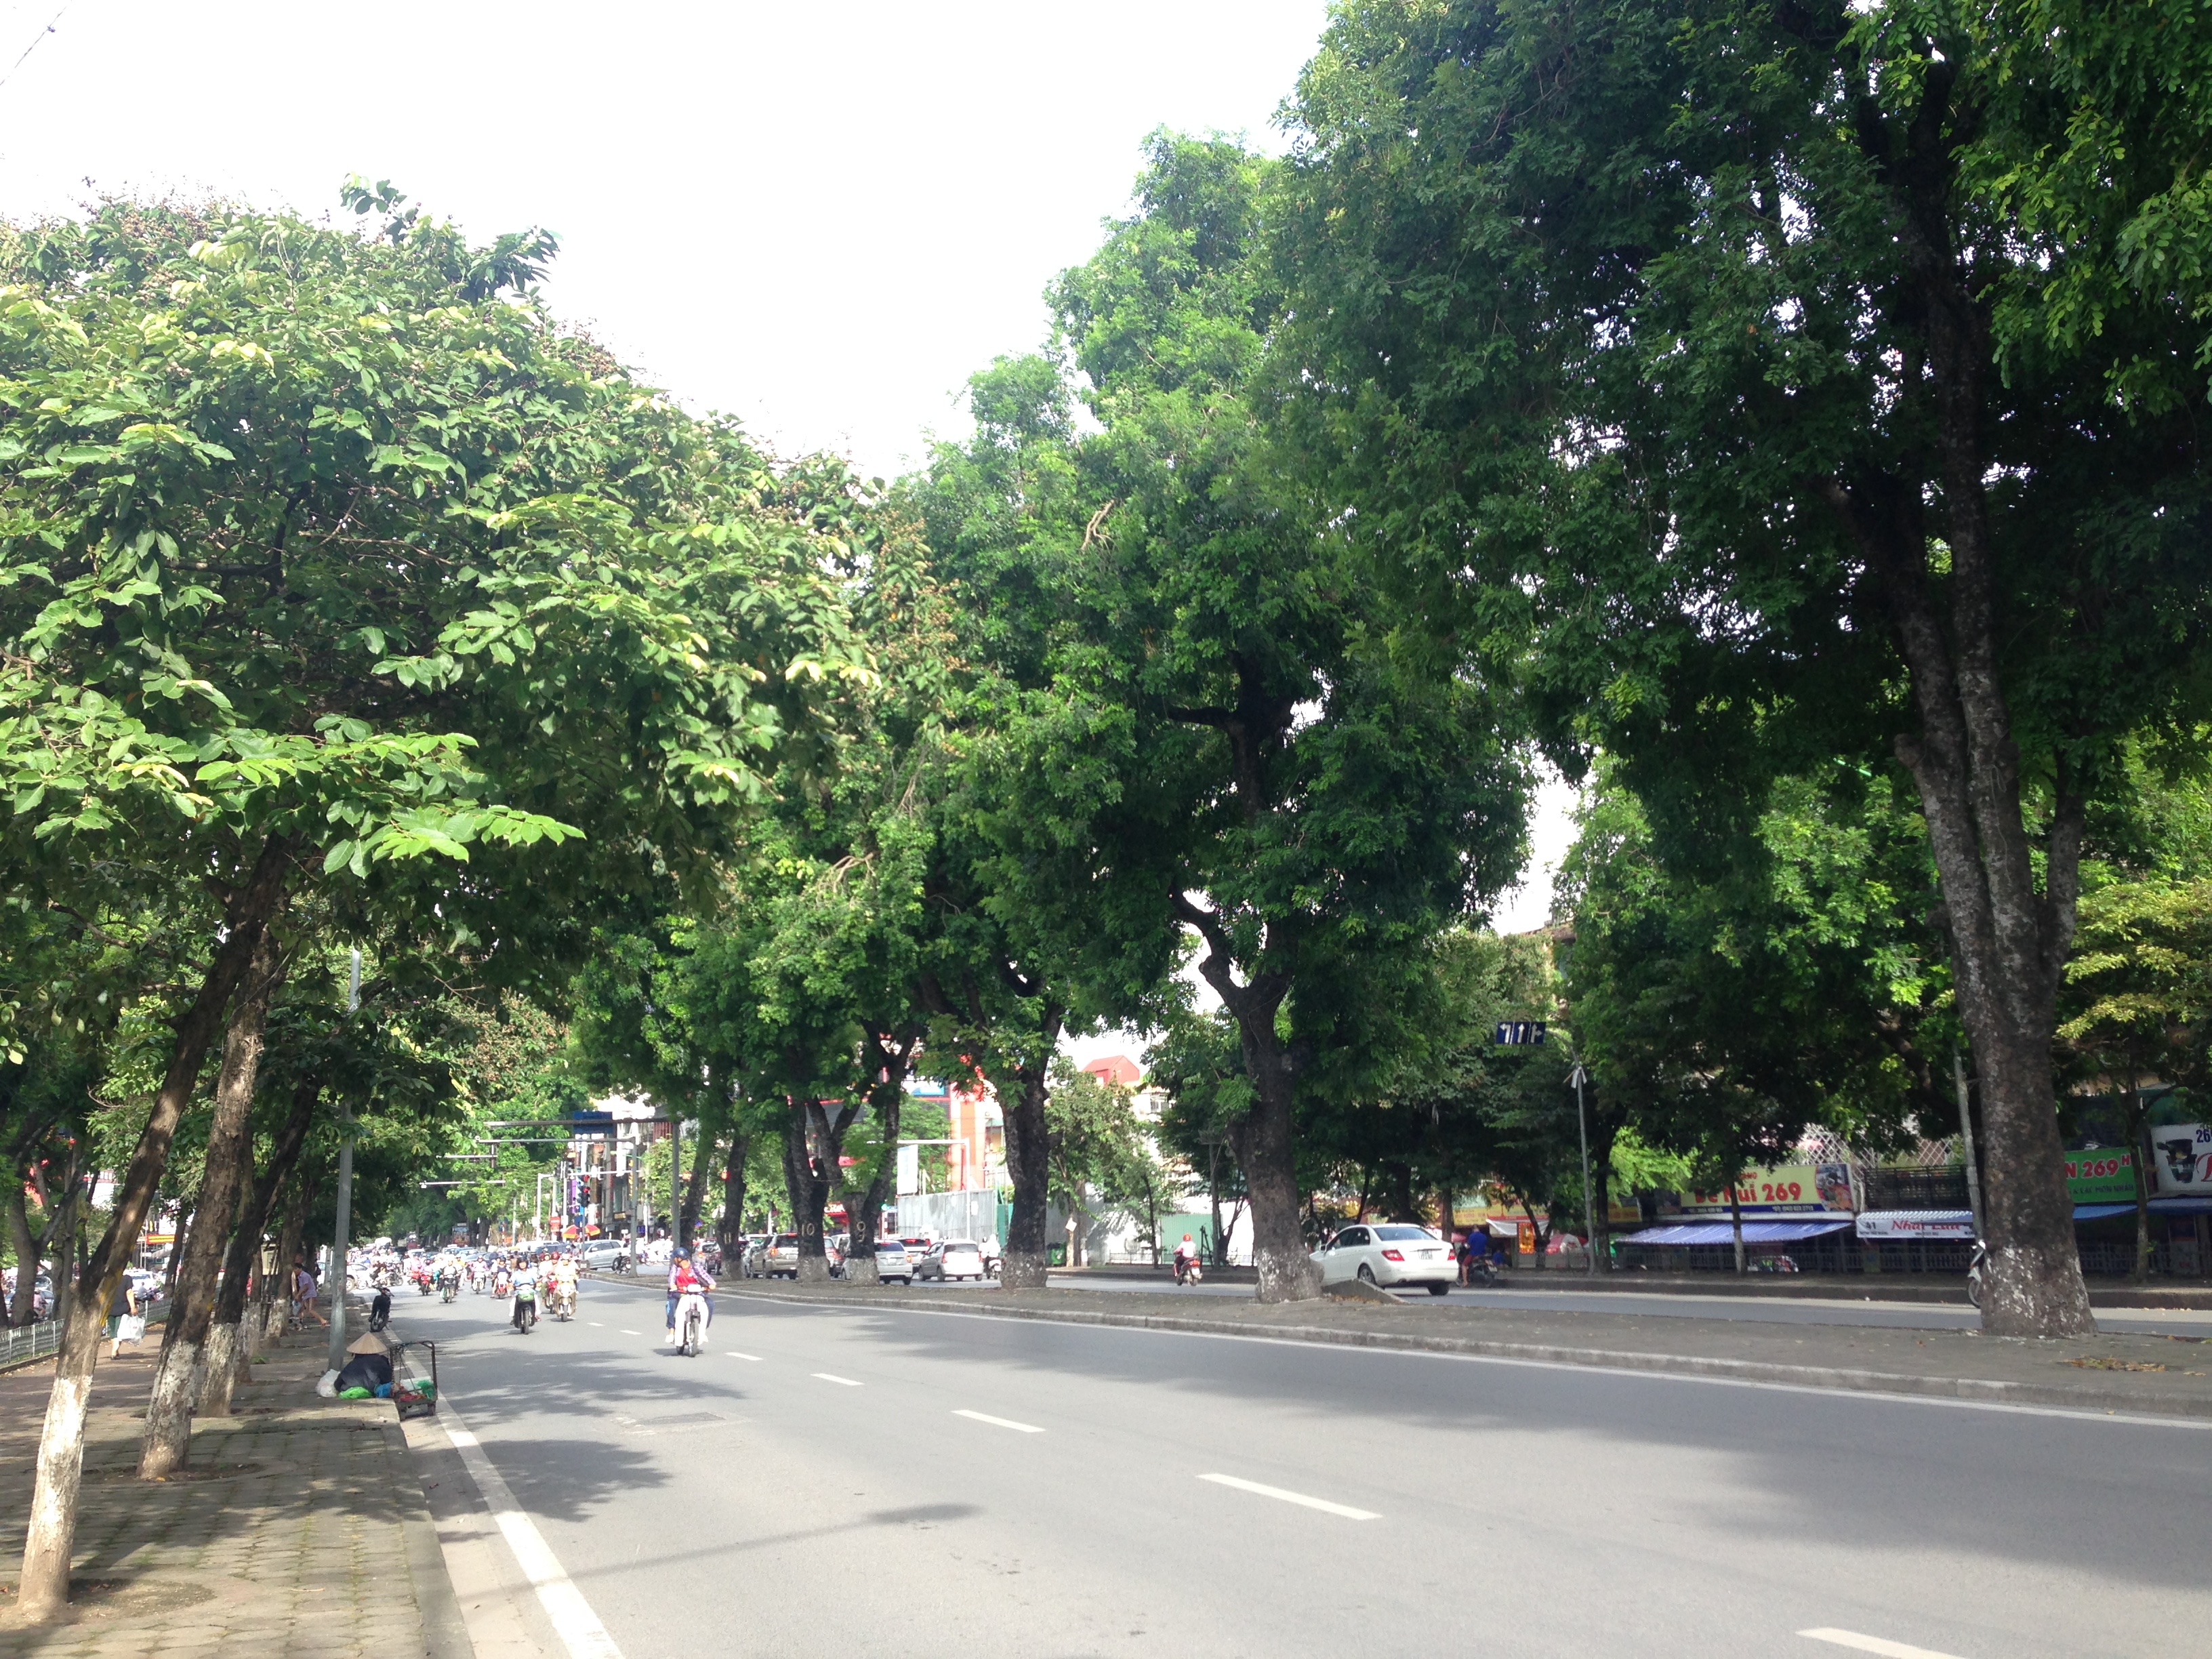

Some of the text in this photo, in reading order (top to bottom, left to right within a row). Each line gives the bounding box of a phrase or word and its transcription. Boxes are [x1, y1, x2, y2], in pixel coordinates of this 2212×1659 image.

[2196, 1128, 2212, 1143] 26
[1762, 1182, 1801, 1202] 269
[802, 1223, 815, 1237] 10
